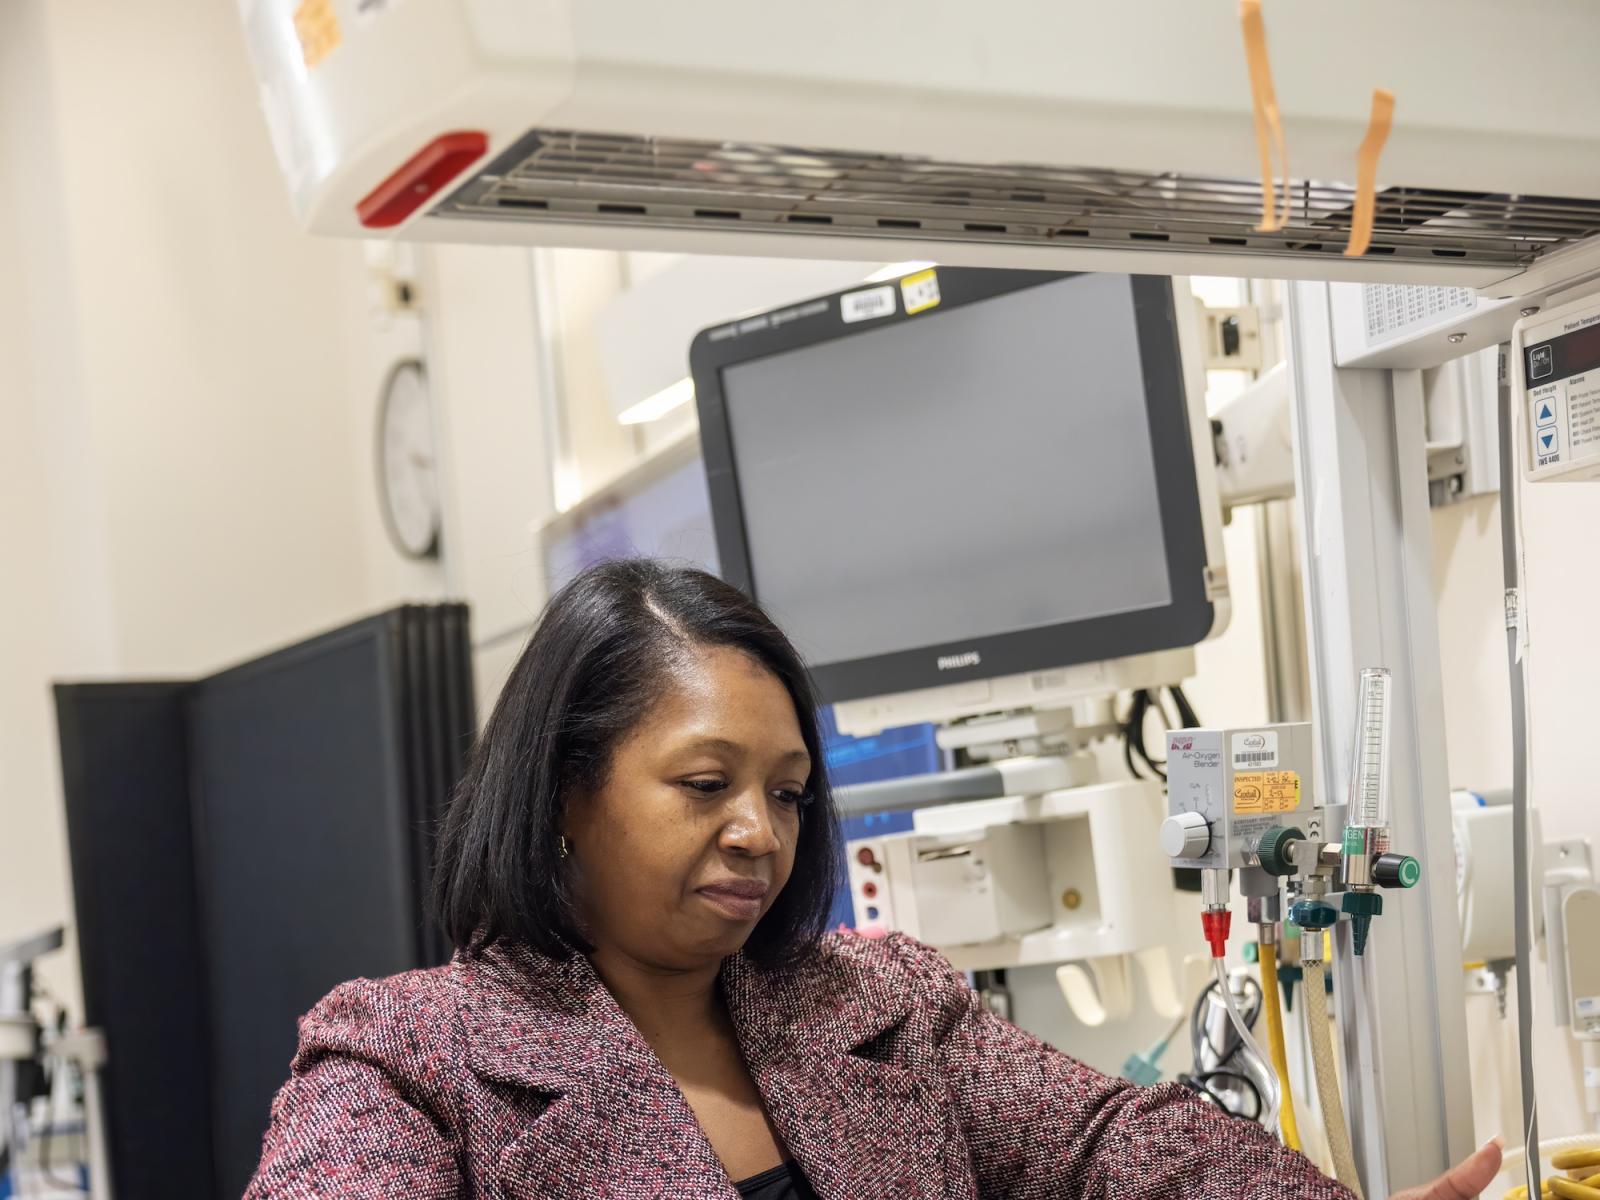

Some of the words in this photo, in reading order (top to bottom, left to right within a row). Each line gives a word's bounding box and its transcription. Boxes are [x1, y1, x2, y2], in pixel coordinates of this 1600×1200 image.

[1564, 320, 1580, 332] Patient
[1533, 351, 1546, 361] Light
[1533, 389, 1542, 397] Bed
[937, 651, 981, 670] PHILIPS
[1182, 752, 1220, 761] Air-Oxygen
